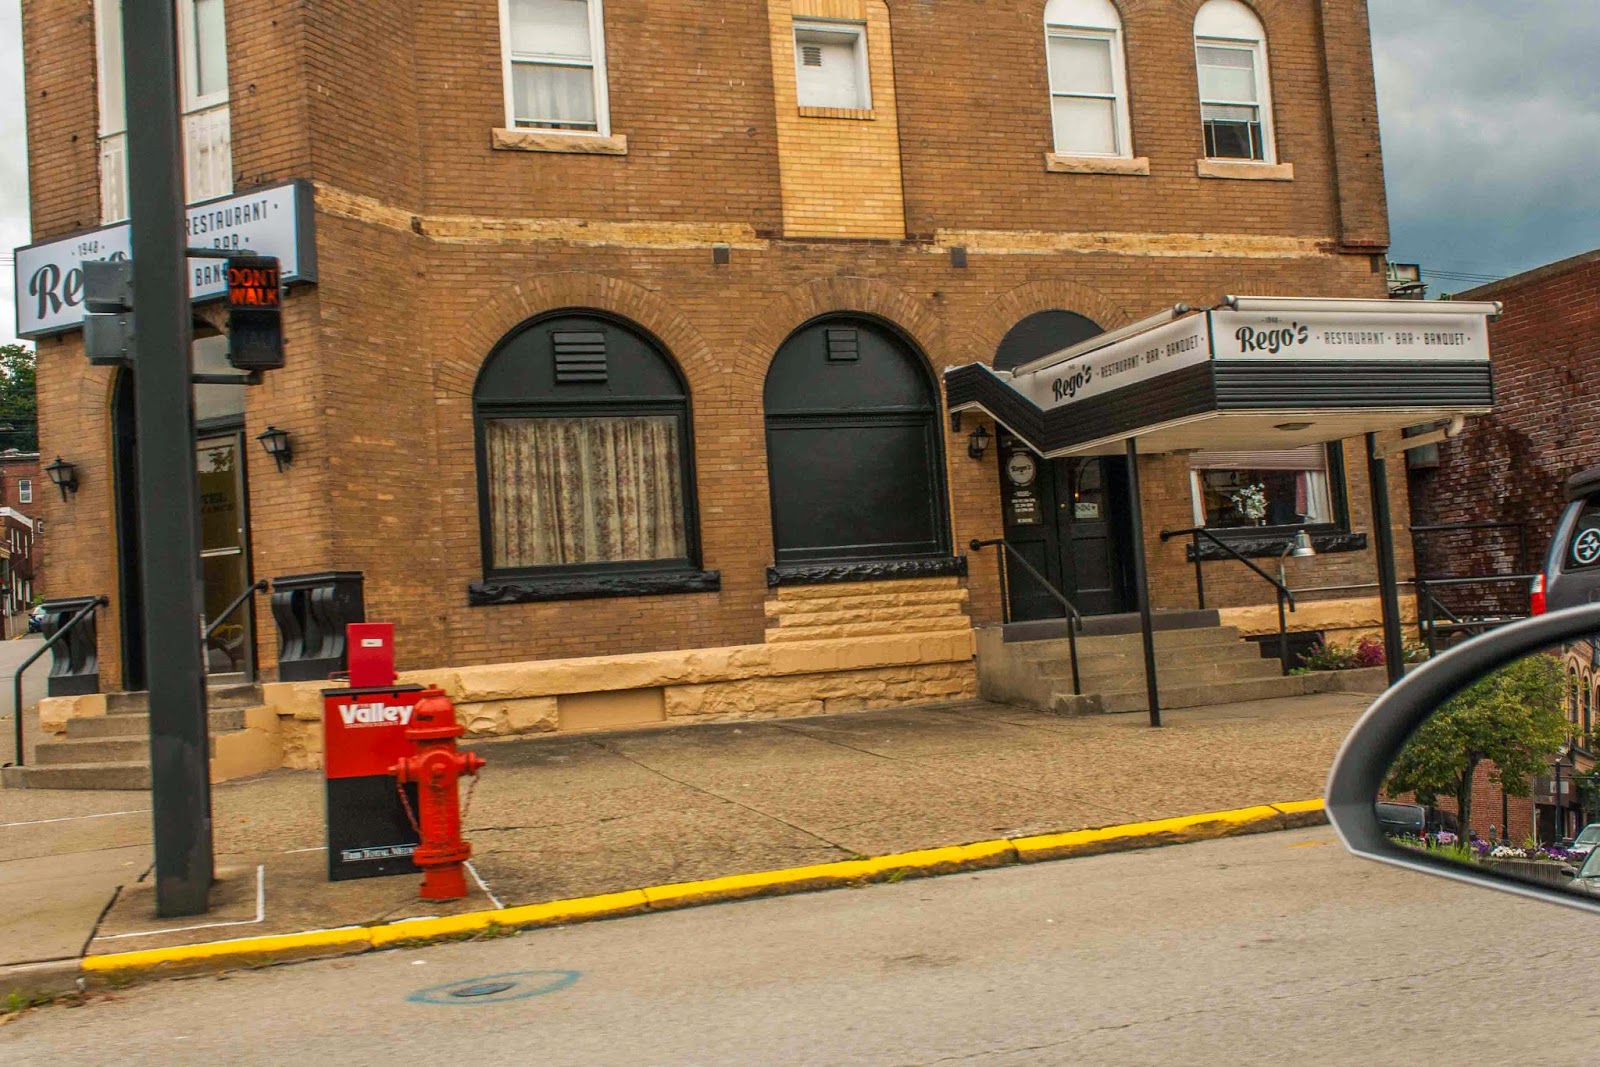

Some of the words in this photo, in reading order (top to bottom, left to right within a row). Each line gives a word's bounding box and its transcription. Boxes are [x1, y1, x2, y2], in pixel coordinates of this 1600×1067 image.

[78, 241, 98, 256] 1948
[214, 234, 239, 250] BAR
[227, 267, 278, 287] DONT
[230, 287, 279, 305] WALK
[1235, 321, 1308, 353] Rego's
[1324, 332, 1384, 345] RESTAURANT
[1396, 332, 1413, 345] BAR
[1424, 332, 1464, 345] BANQUET
[1052, 364, 1092, 402] Rego's
[1101, 355, 1140, 378] RESTAURANT
[1146, 348, 1160, 363] BAR
[1166, 335, 1198, 357] BANQUET
[338, 703, 414, 725] Valley
